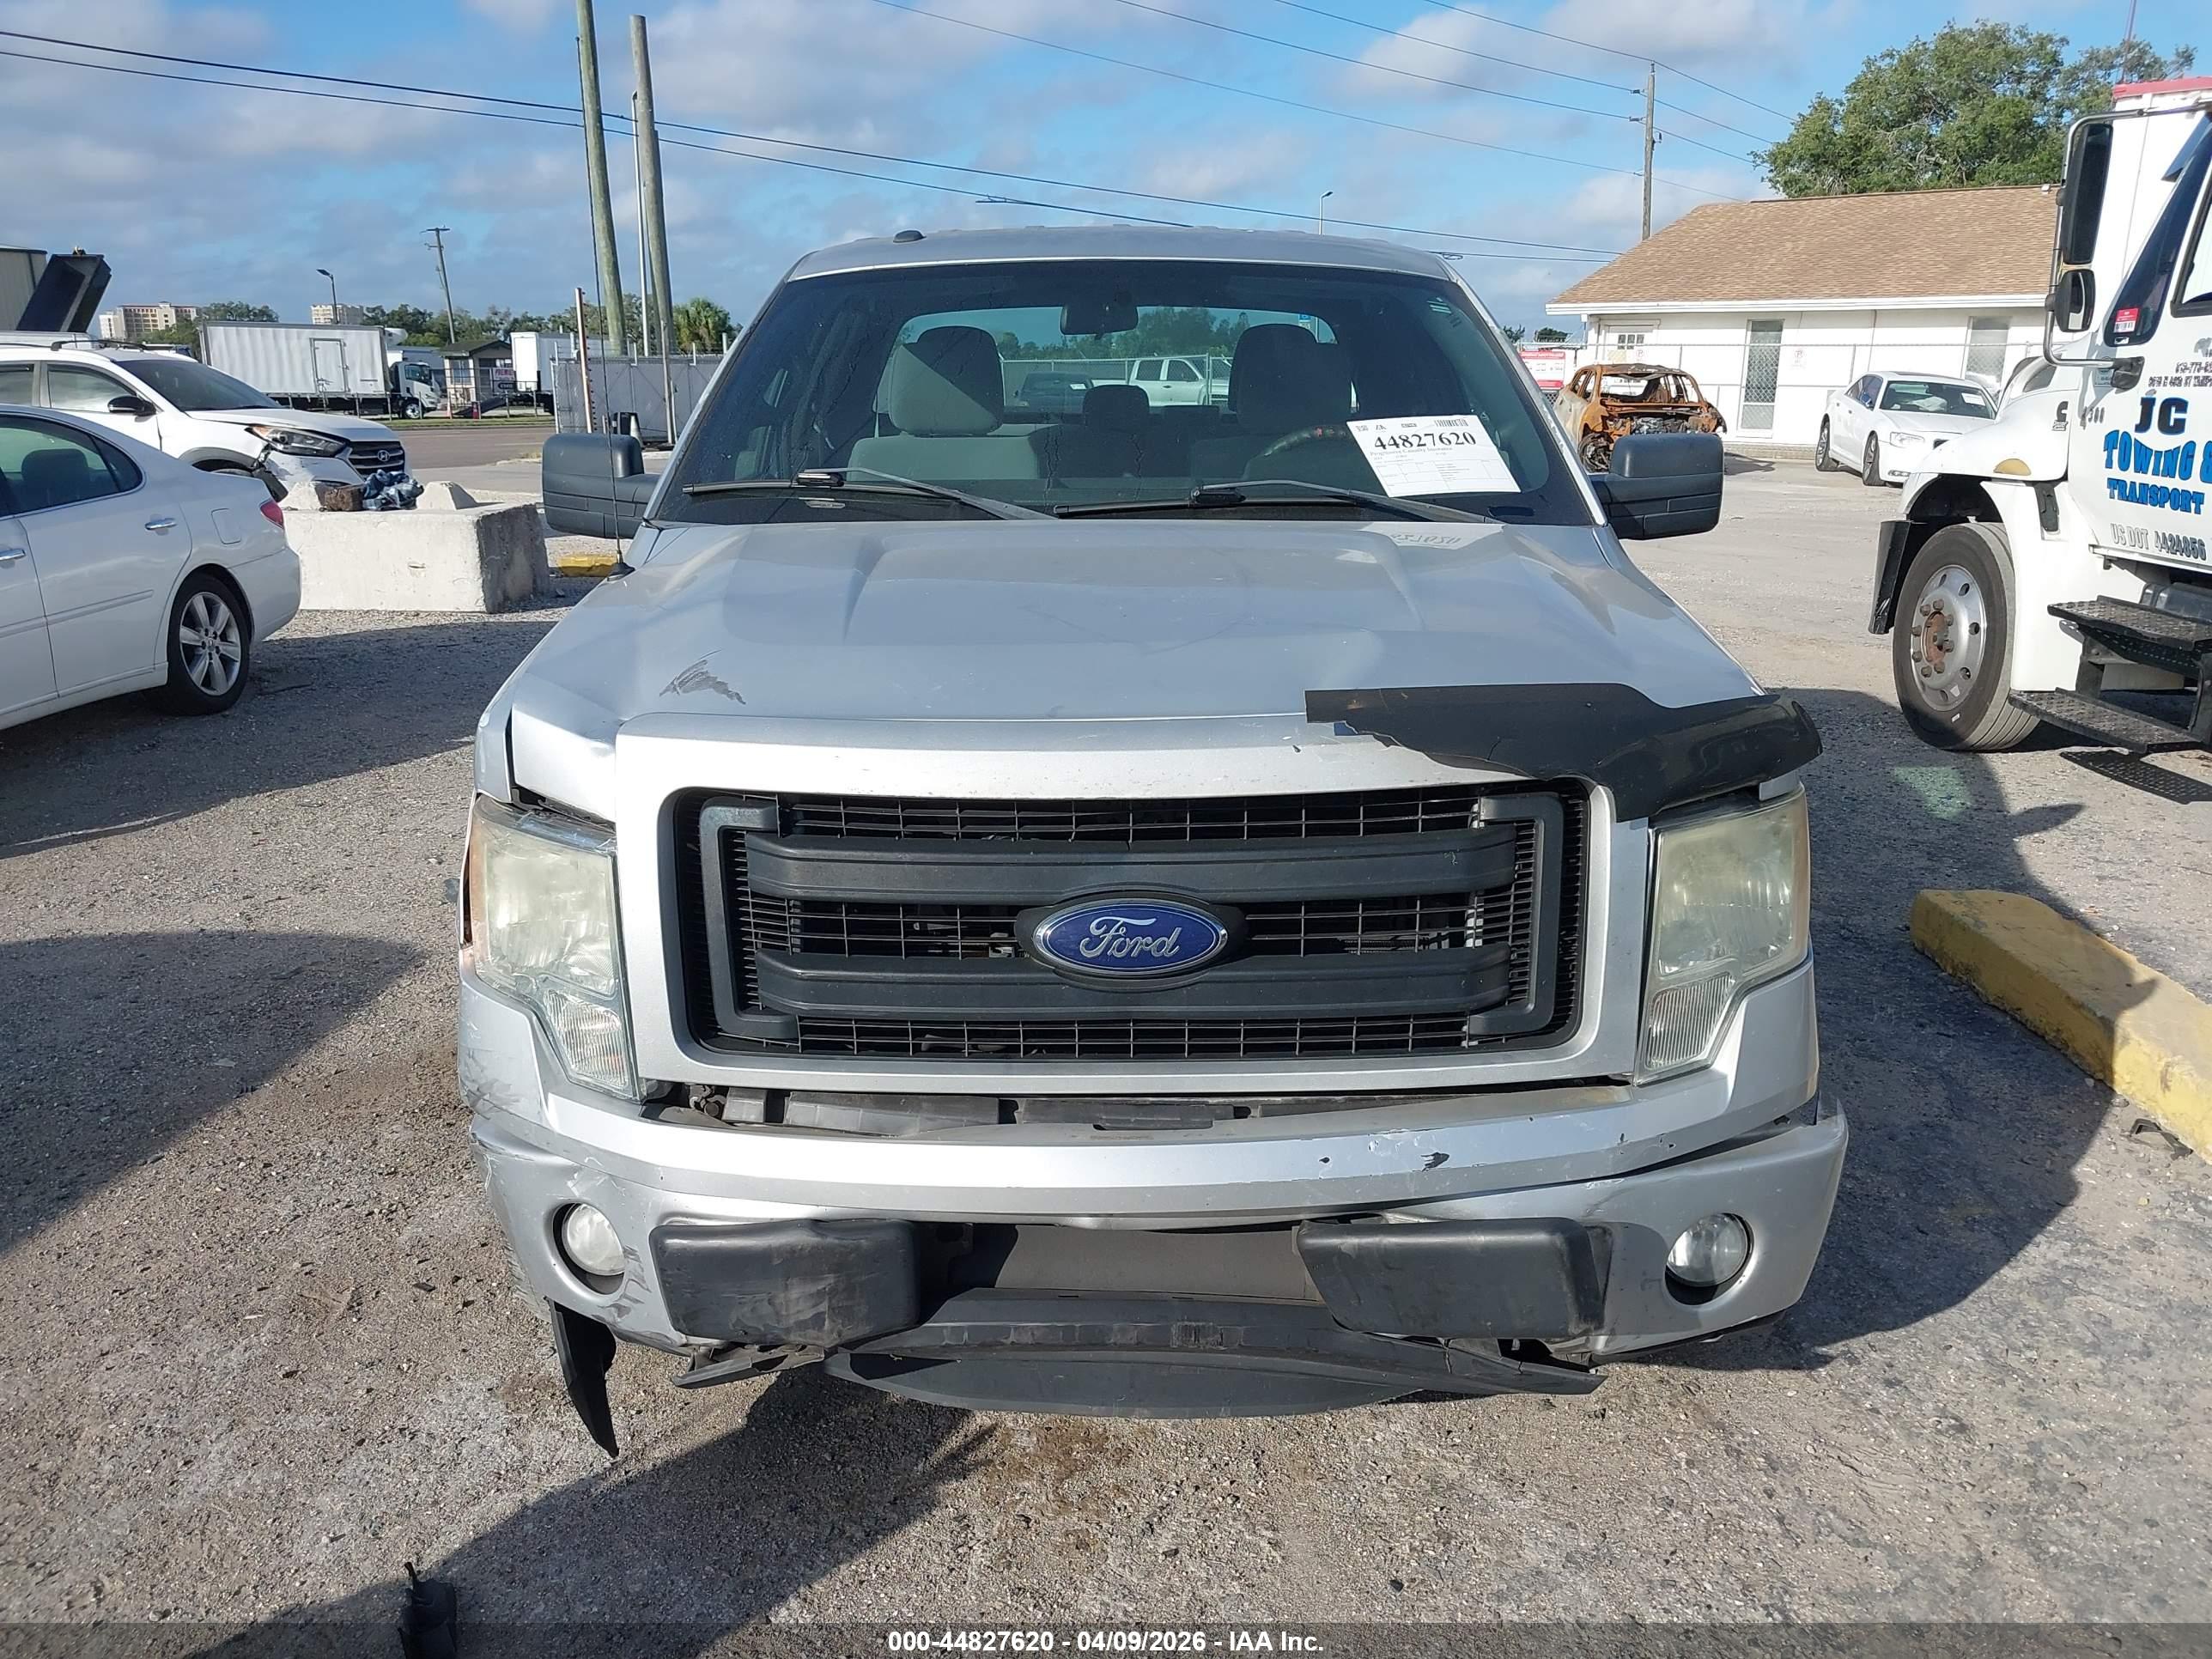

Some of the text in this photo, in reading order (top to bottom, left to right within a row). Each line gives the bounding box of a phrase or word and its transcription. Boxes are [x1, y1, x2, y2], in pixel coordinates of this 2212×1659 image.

[2135, 397, 2189, 435] JC
[1375, 431, 1476, 449] 44827620
[2104, 429, 2197, 481] TOWING
[2107, 477, 2205, 514] TRANSPORT
[2110, 523, 2126, 545] US
[2126, 526, 2149, 550] DOT
[1079, 916, 1182, 957] Ford
